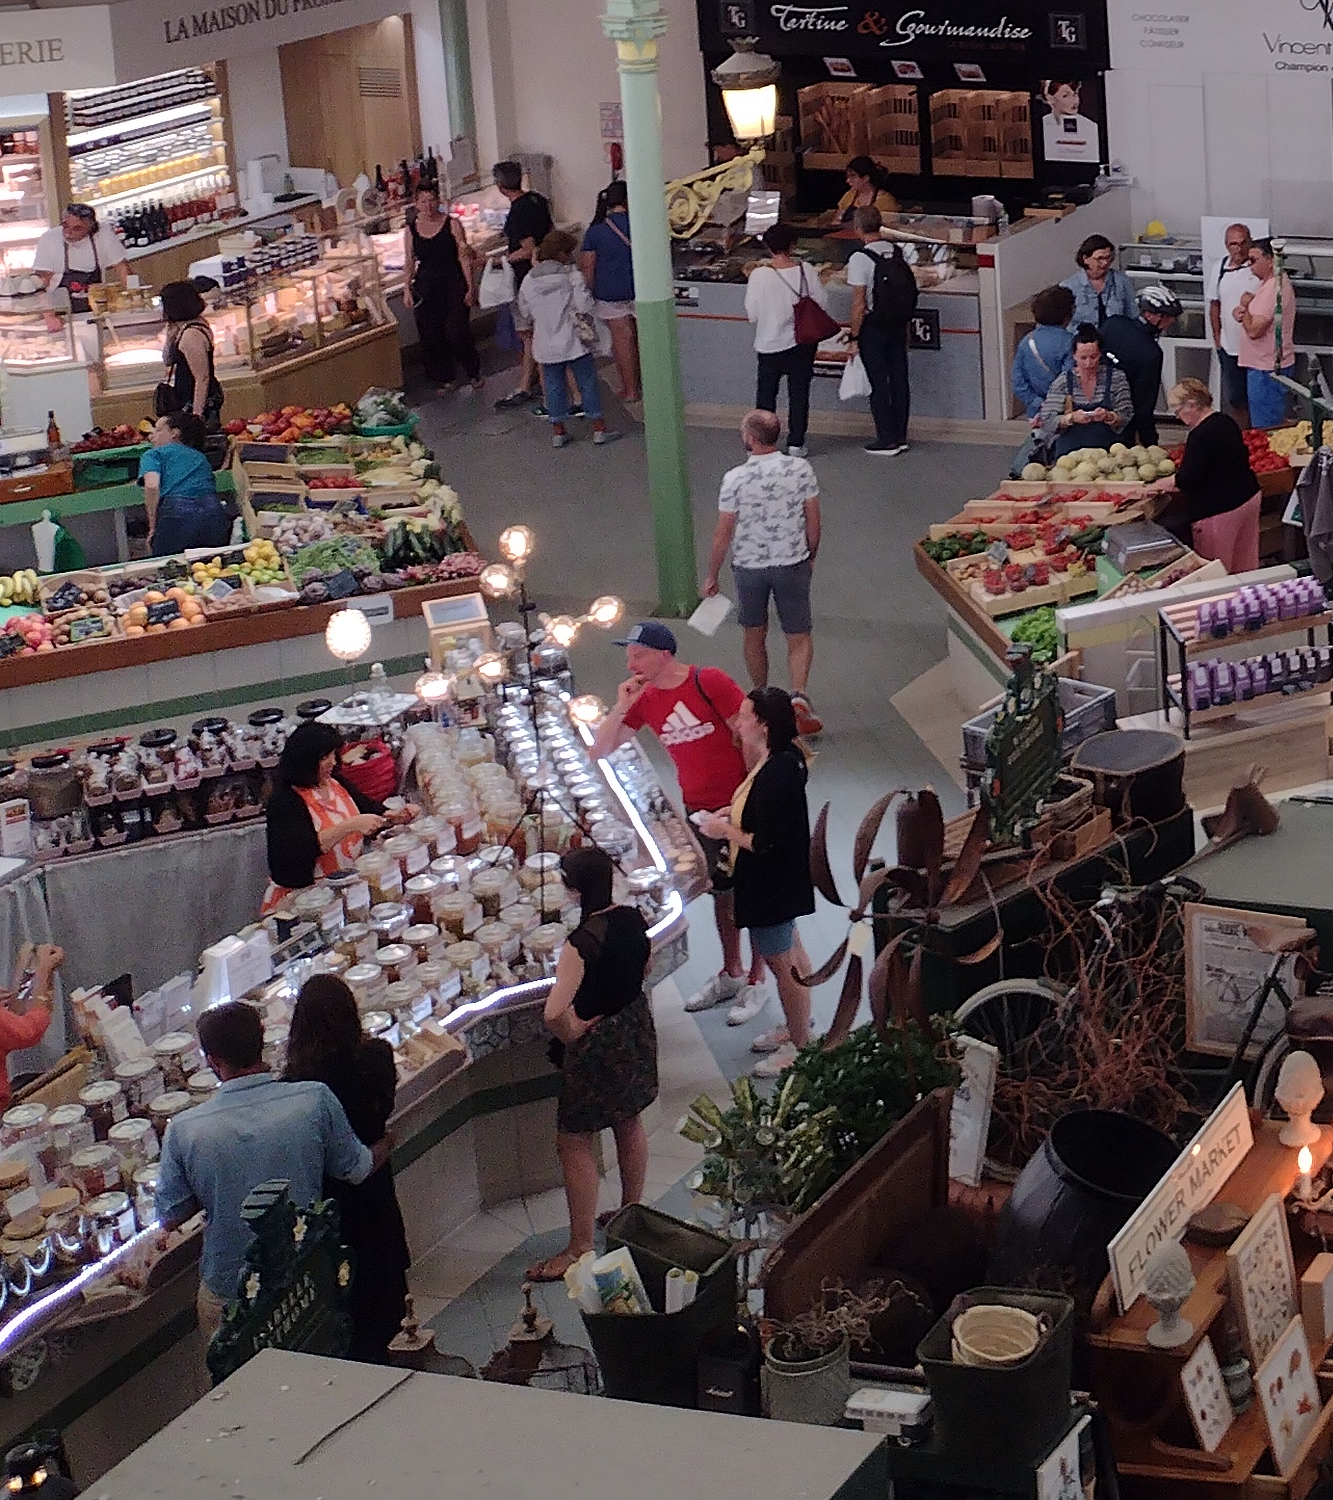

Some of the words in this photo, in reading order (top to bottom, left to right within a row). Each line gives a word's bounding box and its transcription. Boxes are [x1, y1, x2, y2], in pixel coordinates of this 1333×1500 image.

[164, 18, 190, 44] LA
[191, 0, 262, 38] MAISON
[770, 4, 849, 32] Tartine
[856, 10, 889, 36] &
[879, 9, 1033, 47] Gourmandise
[1262, 32, 1333, 56] Vincent
[1274, 60, 1329, 73] Champion
[1128, 1187, 1187, 1286] FLOWER
[1188, 1122, 1241, 1197] MARKET
